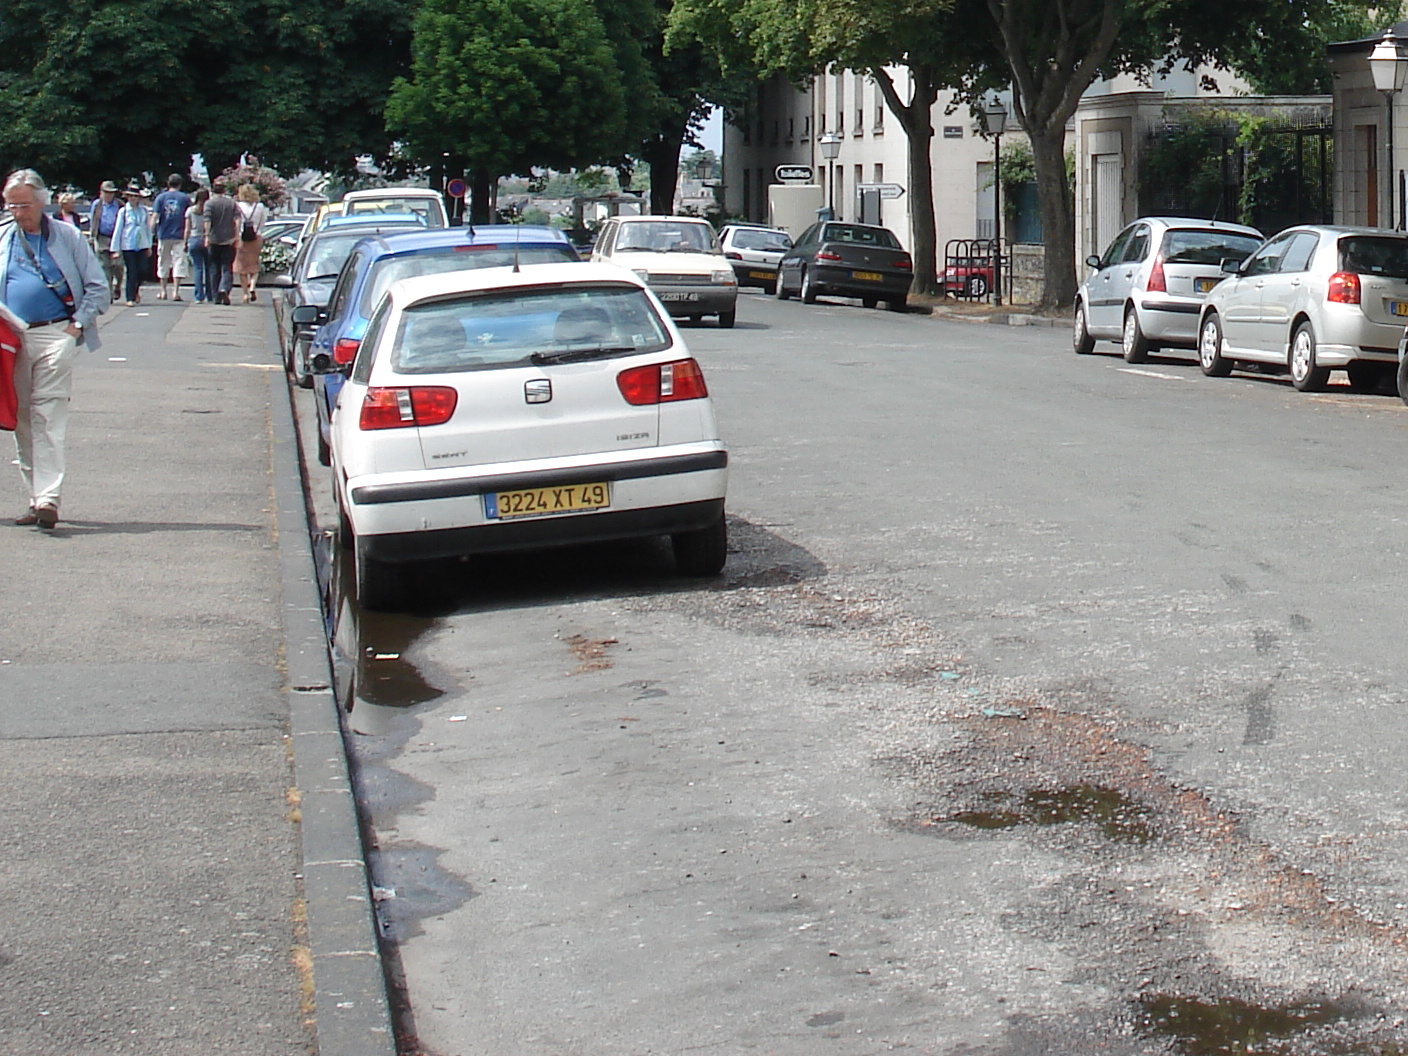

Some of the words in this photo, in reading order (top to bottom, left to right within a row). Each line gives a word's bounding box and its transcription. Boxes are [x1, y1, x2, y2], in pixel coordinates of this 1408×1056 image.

[499, 491, 548, 514] 3224
[552, 488, 575, 508] XT
[581, 485, 604, 505] 49
